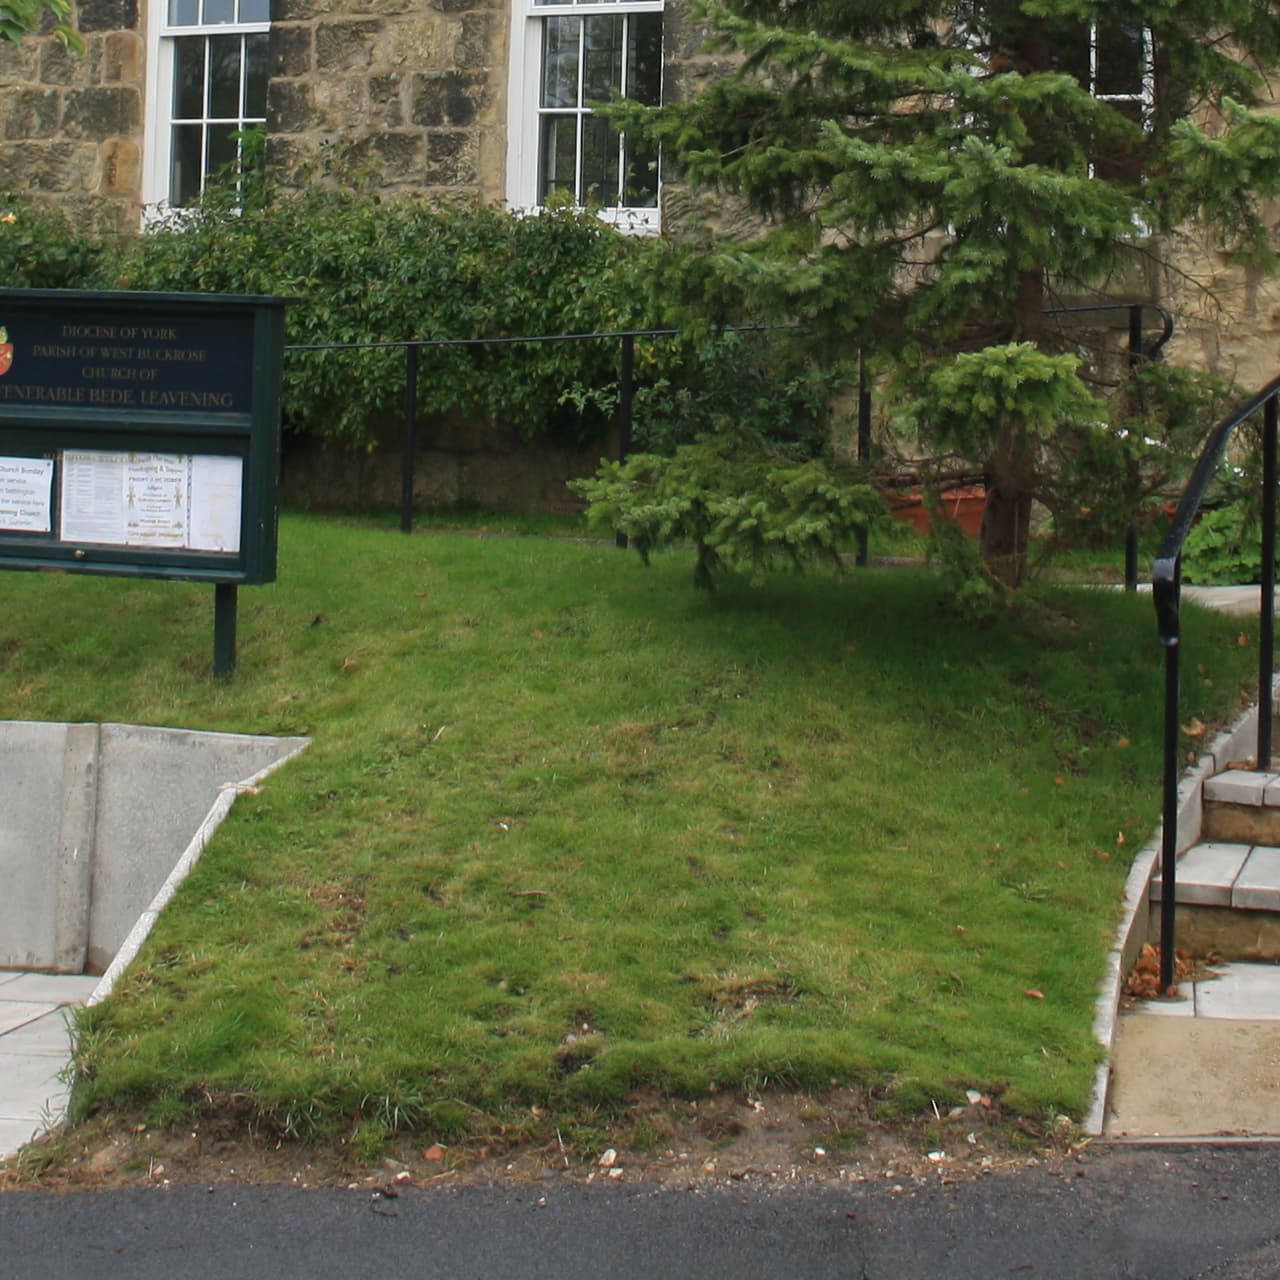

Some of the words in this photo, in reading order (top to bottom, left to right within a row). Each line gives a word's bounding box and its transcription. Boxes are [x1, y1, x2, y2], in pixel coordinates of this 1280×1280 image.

[62, 325, 118, 338] DIOCESE
[120, 327, 138, 339] OF
[141, 327, 177, 340] YORK
[32, 344, 76, 358] PARISH
[79, 346, 97, 359] OF
[99, 347, 135, 360] WEST
[137, 348, 208, 362] BUCKROSE
[81, 367, 138, 380] CHURCH
[140, 368, 159, 381] OF
[140, 389, 233, 408] LEAVENING
